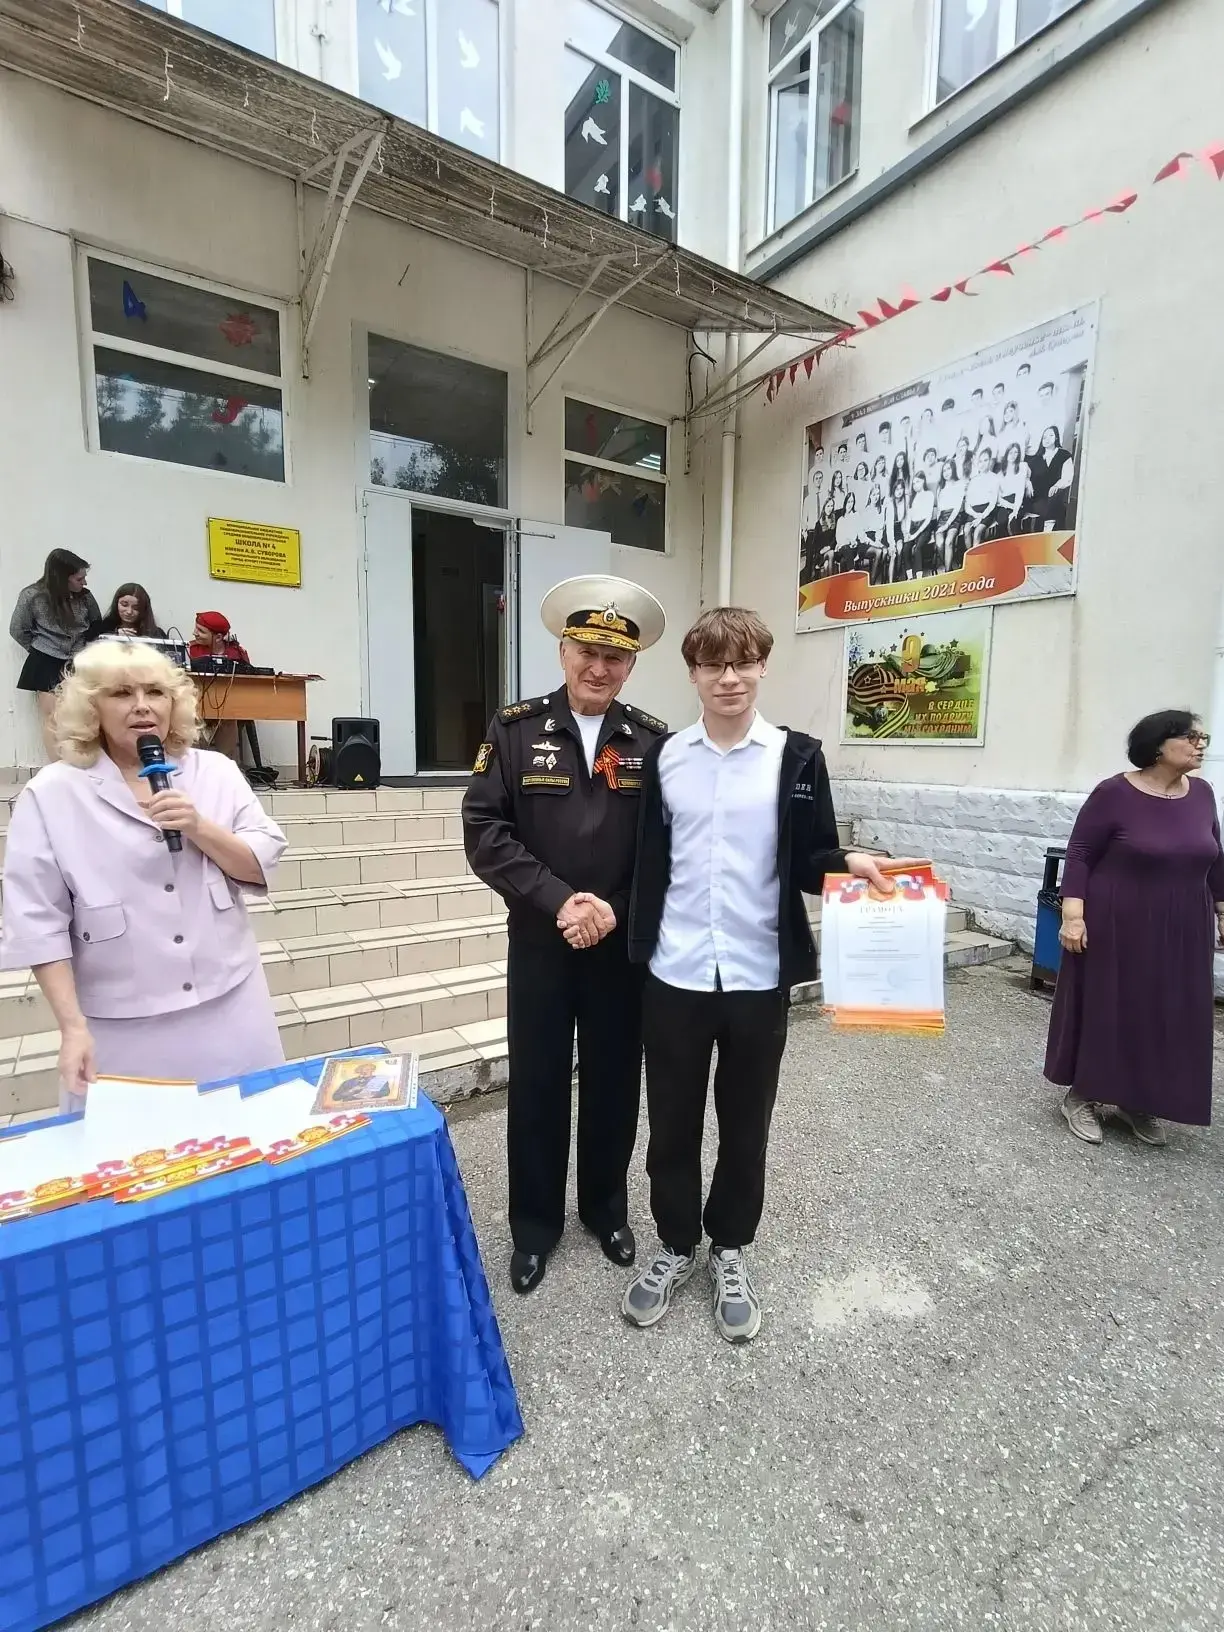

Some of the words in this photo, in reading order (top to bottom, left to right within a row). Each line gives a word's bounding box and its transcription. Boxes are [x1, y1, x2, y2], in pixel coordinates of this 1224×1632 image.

[235, 538, 261, 548] ШКОЛА
[257, 550, 286, 558] СУВОРОВА
[843, 592, 919, 613] Выпускники
[922, 581, 956, 599] 2021
[959, 576, 996, 594] года
[901, 634, 922, 673] 9
